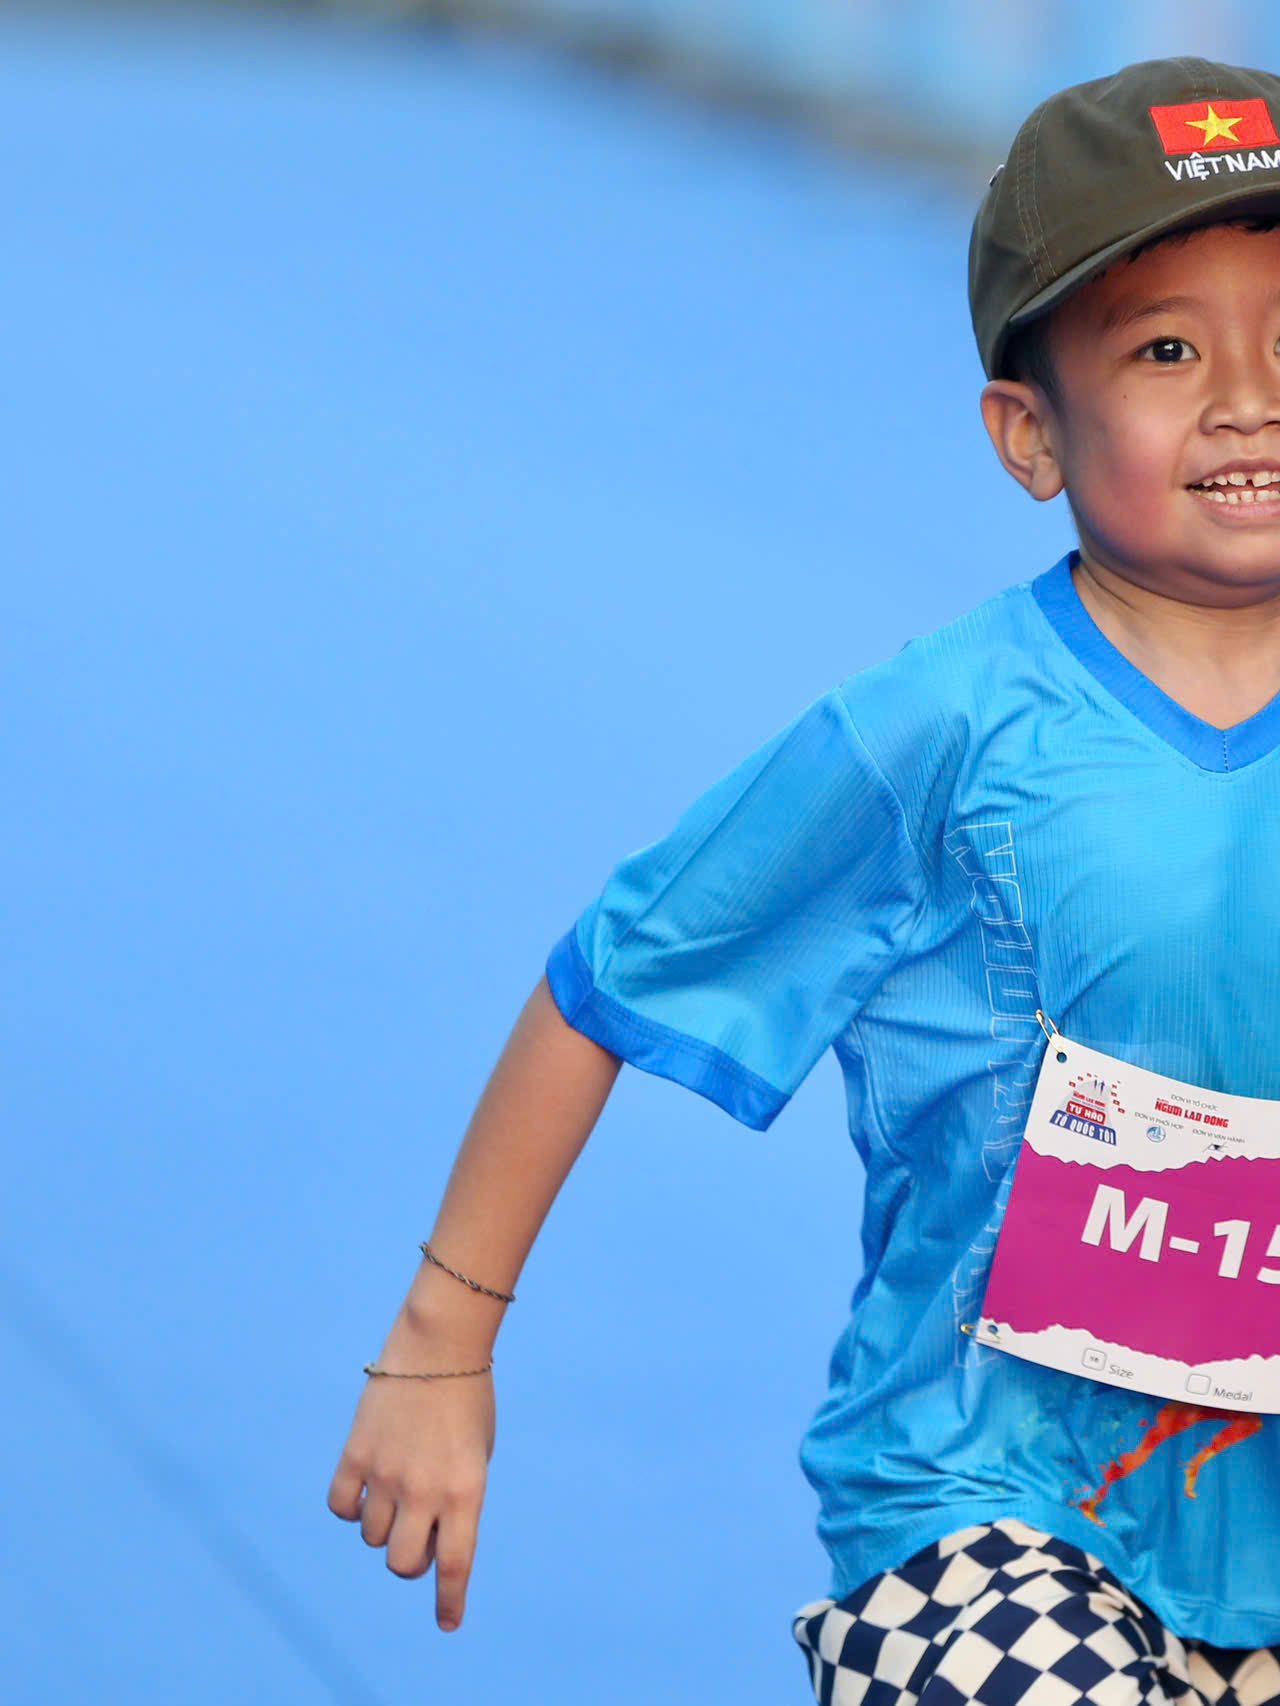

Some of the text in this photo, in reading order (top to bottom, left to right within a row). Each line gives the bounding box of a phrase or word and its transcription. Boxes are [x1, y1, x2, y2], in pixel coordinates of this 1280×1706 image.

[1164, 152, 1222, 181] VIỆT
[1184, 1109, 1202, 1122] LAO
[1108, 1363, 1134, 1380] Size
[1213, 1387, 1253, 1402] Medal
